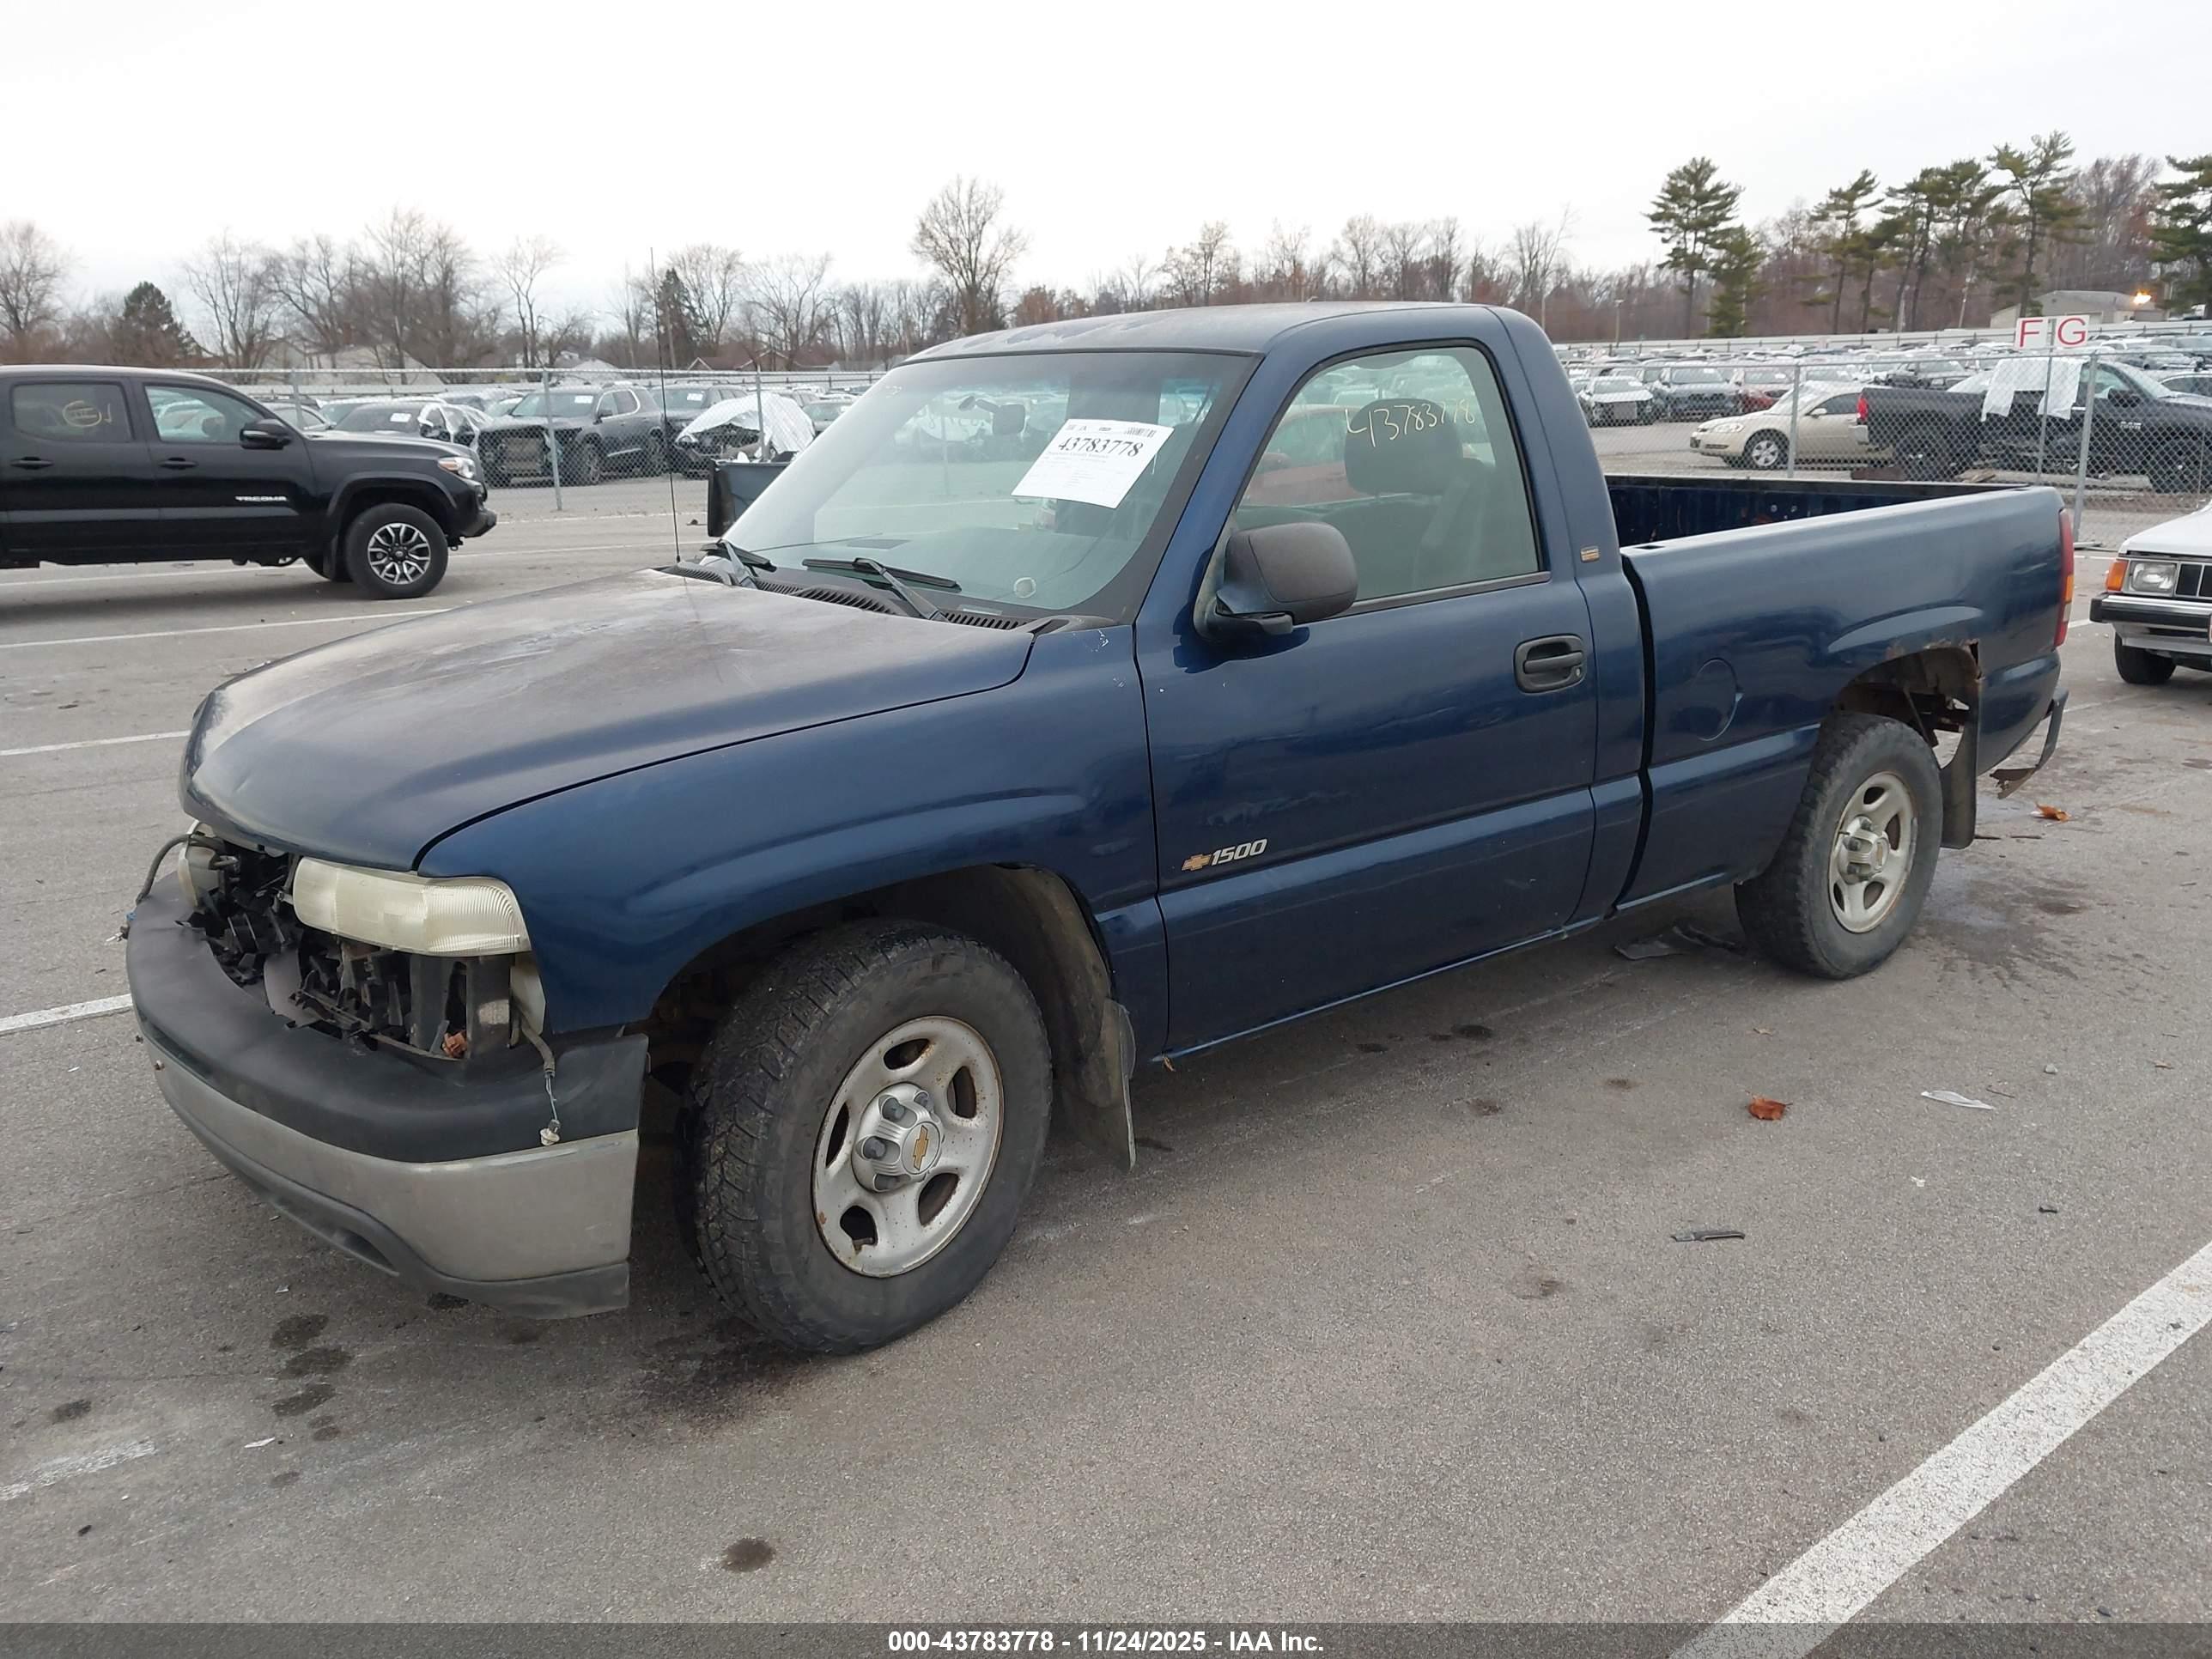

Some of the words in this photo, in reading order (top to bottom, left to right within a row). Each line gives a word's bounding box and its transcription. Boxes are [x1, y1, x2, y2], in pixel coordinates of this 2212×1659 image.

[2020, 319, 2043, 348] F
[2057, 318, 2086, 345] G
[1346, 398, 1475, 447] 43783778
[1058, 436, 1144, 457] 43783778
[1211, 838, 1267, 866] 1500
